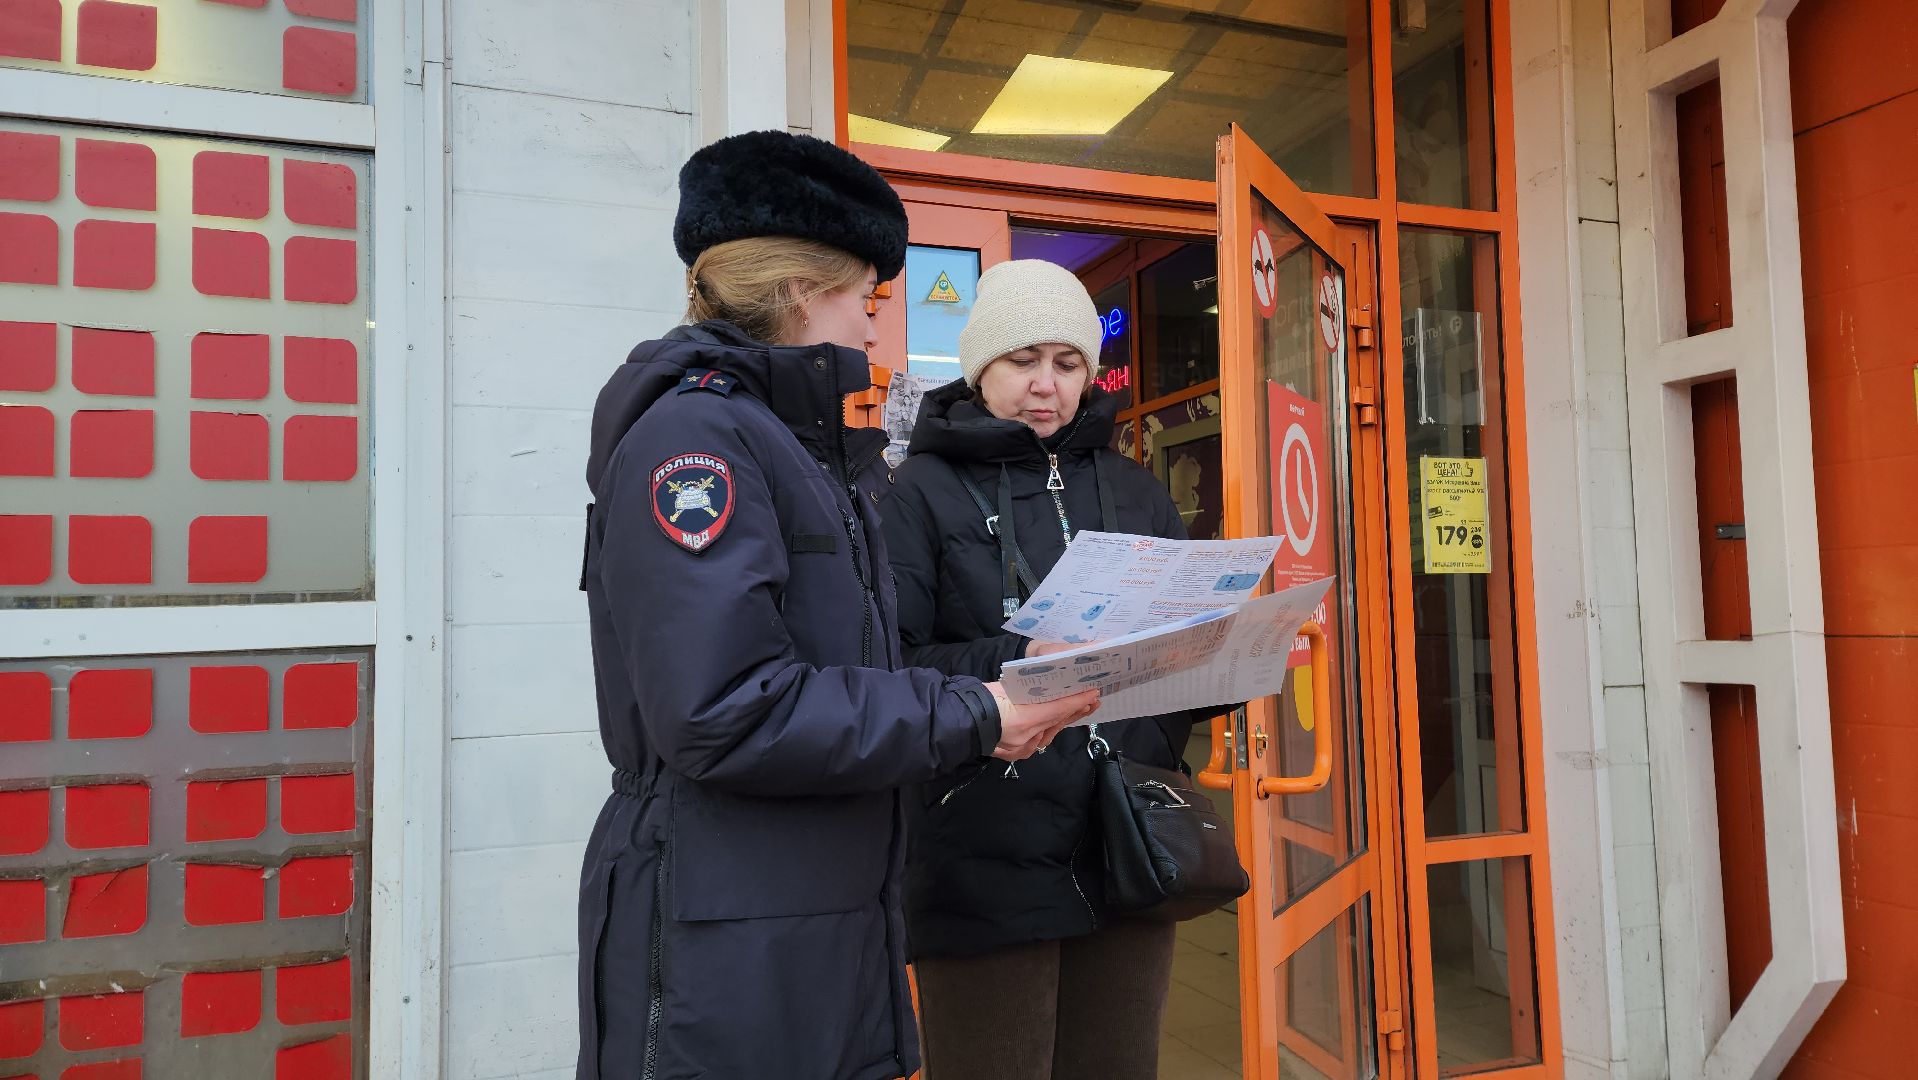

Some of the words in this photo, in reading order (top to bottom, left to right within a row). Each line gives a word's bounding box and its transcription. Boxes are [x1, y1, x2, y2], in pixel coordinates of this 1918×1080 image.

[654, 456, 727, 482] ПОЛИЦИЯ
[1433, 461, 1447, 469] ВОТ
[1437, 469, 1458, 477] ЦЕНА!
[682, 529, 710, 549] МВД
[1436, 525, 1468, 546] 179
